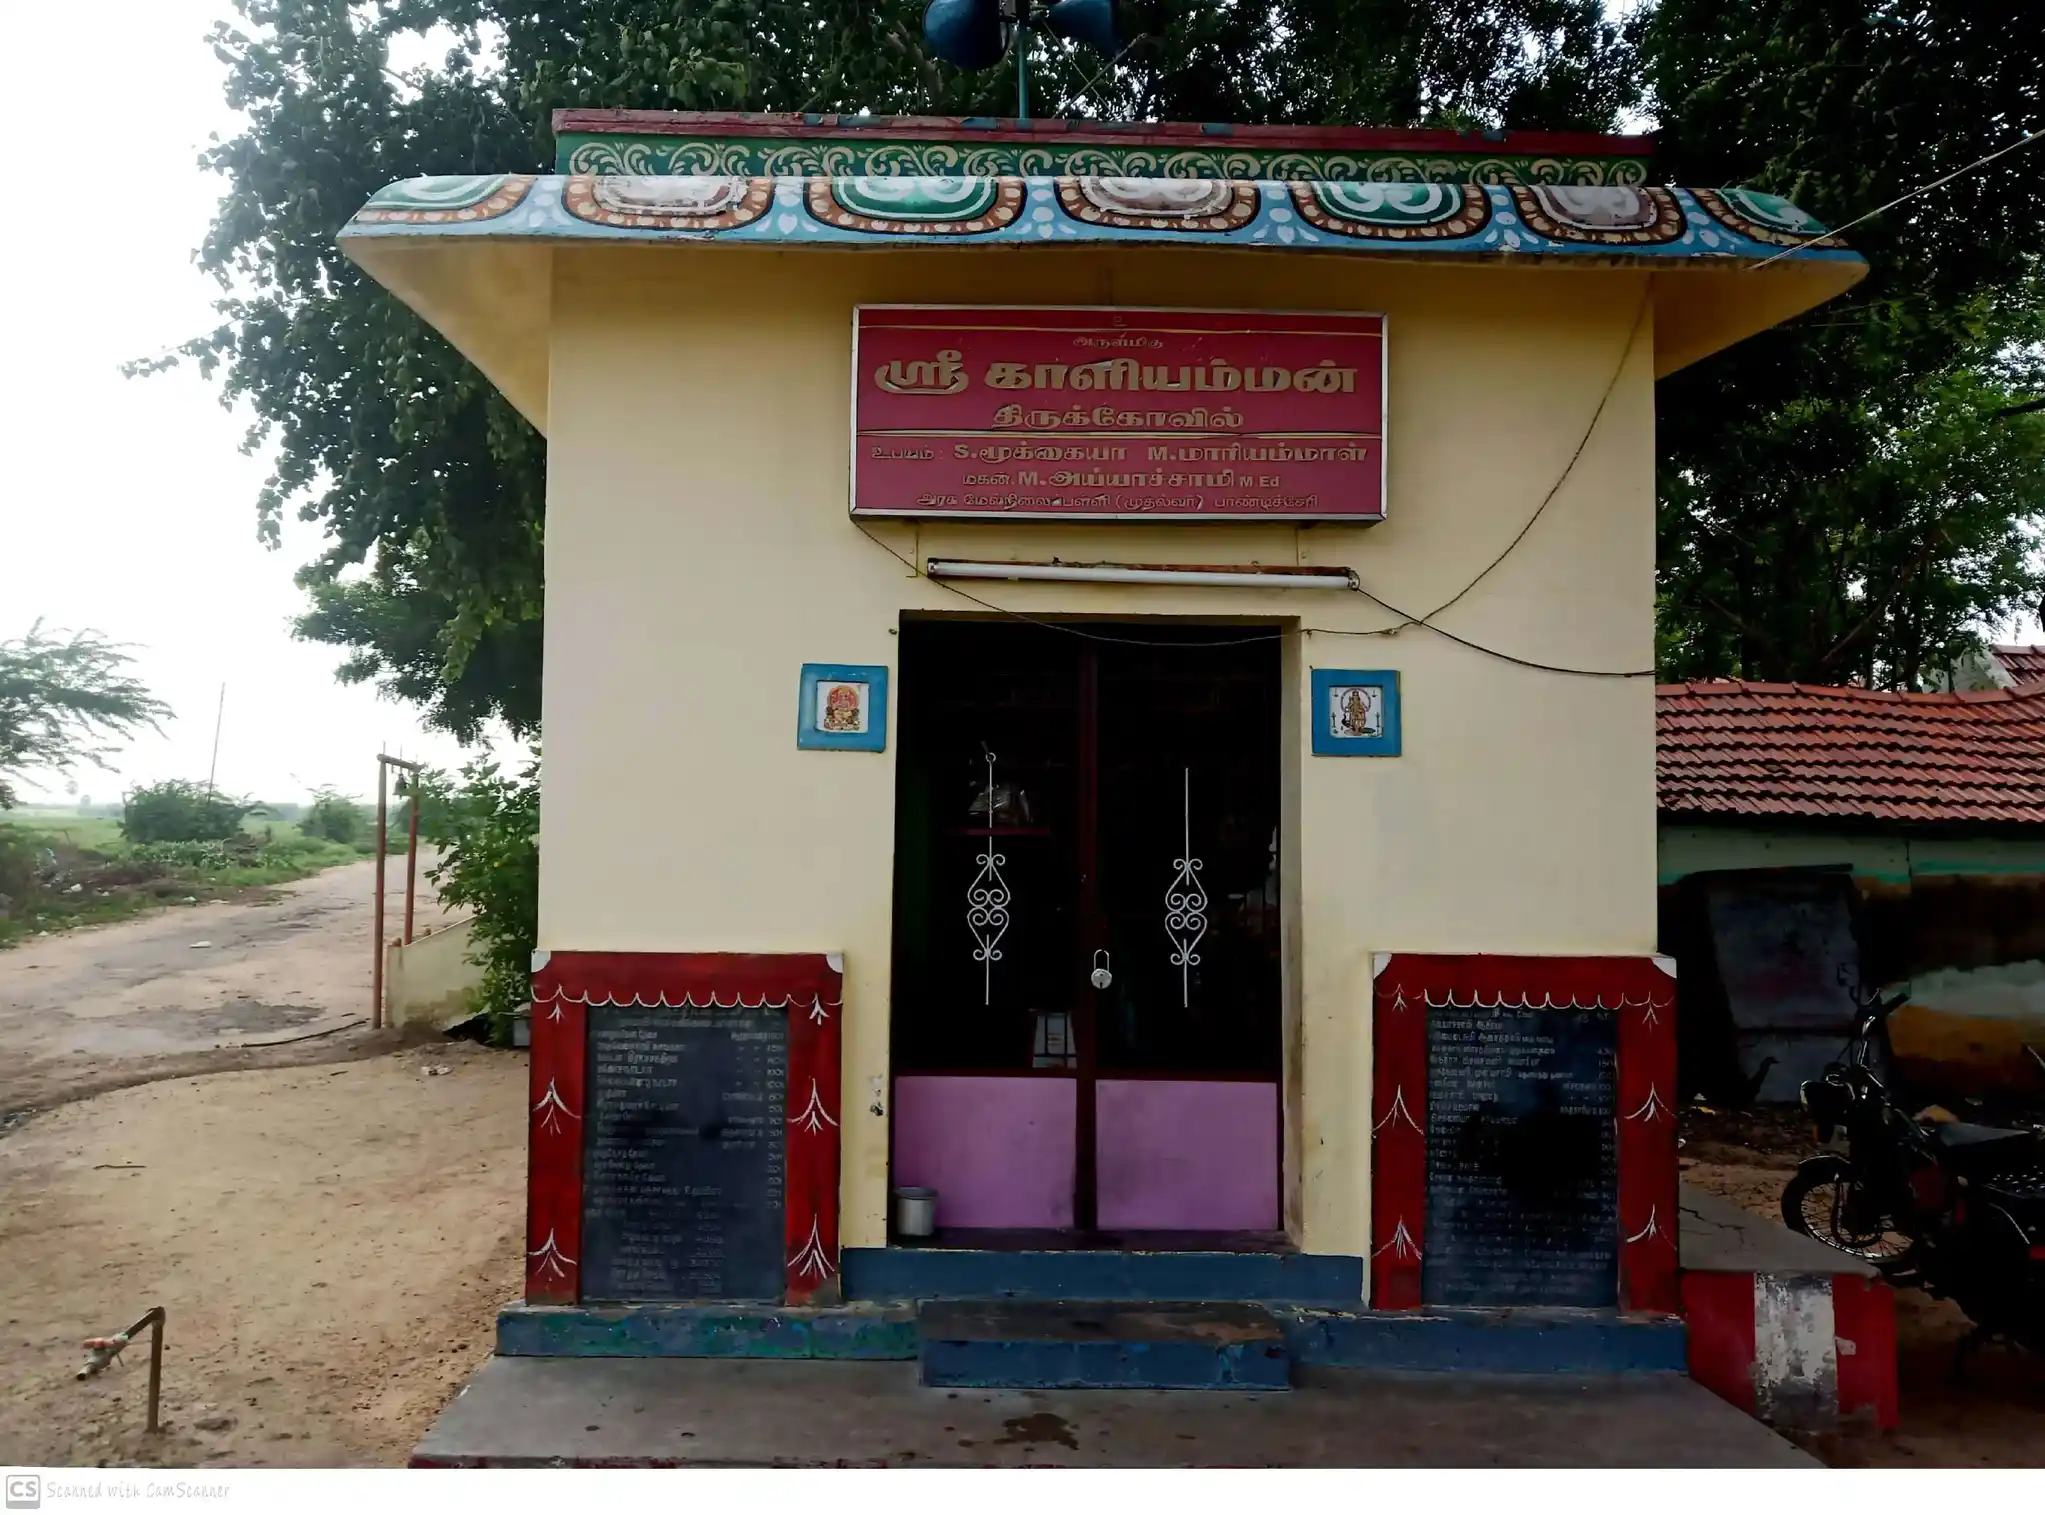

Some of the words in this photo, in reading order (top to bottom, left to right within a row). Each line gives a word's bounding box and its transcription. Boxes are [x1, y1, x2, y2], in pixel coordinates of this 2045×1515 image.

[874, 349, 969, 395] ஸ்ரீ
[984, 357, 1357, 394] காளியம்மன்
[991, 404, 1244, 429] திருக்கோவில்
[1148, 442, 1367, 462] M.மாரியம்மாள்
[1018, 467, 1234, 487] M.அய்யாச்சாமி
